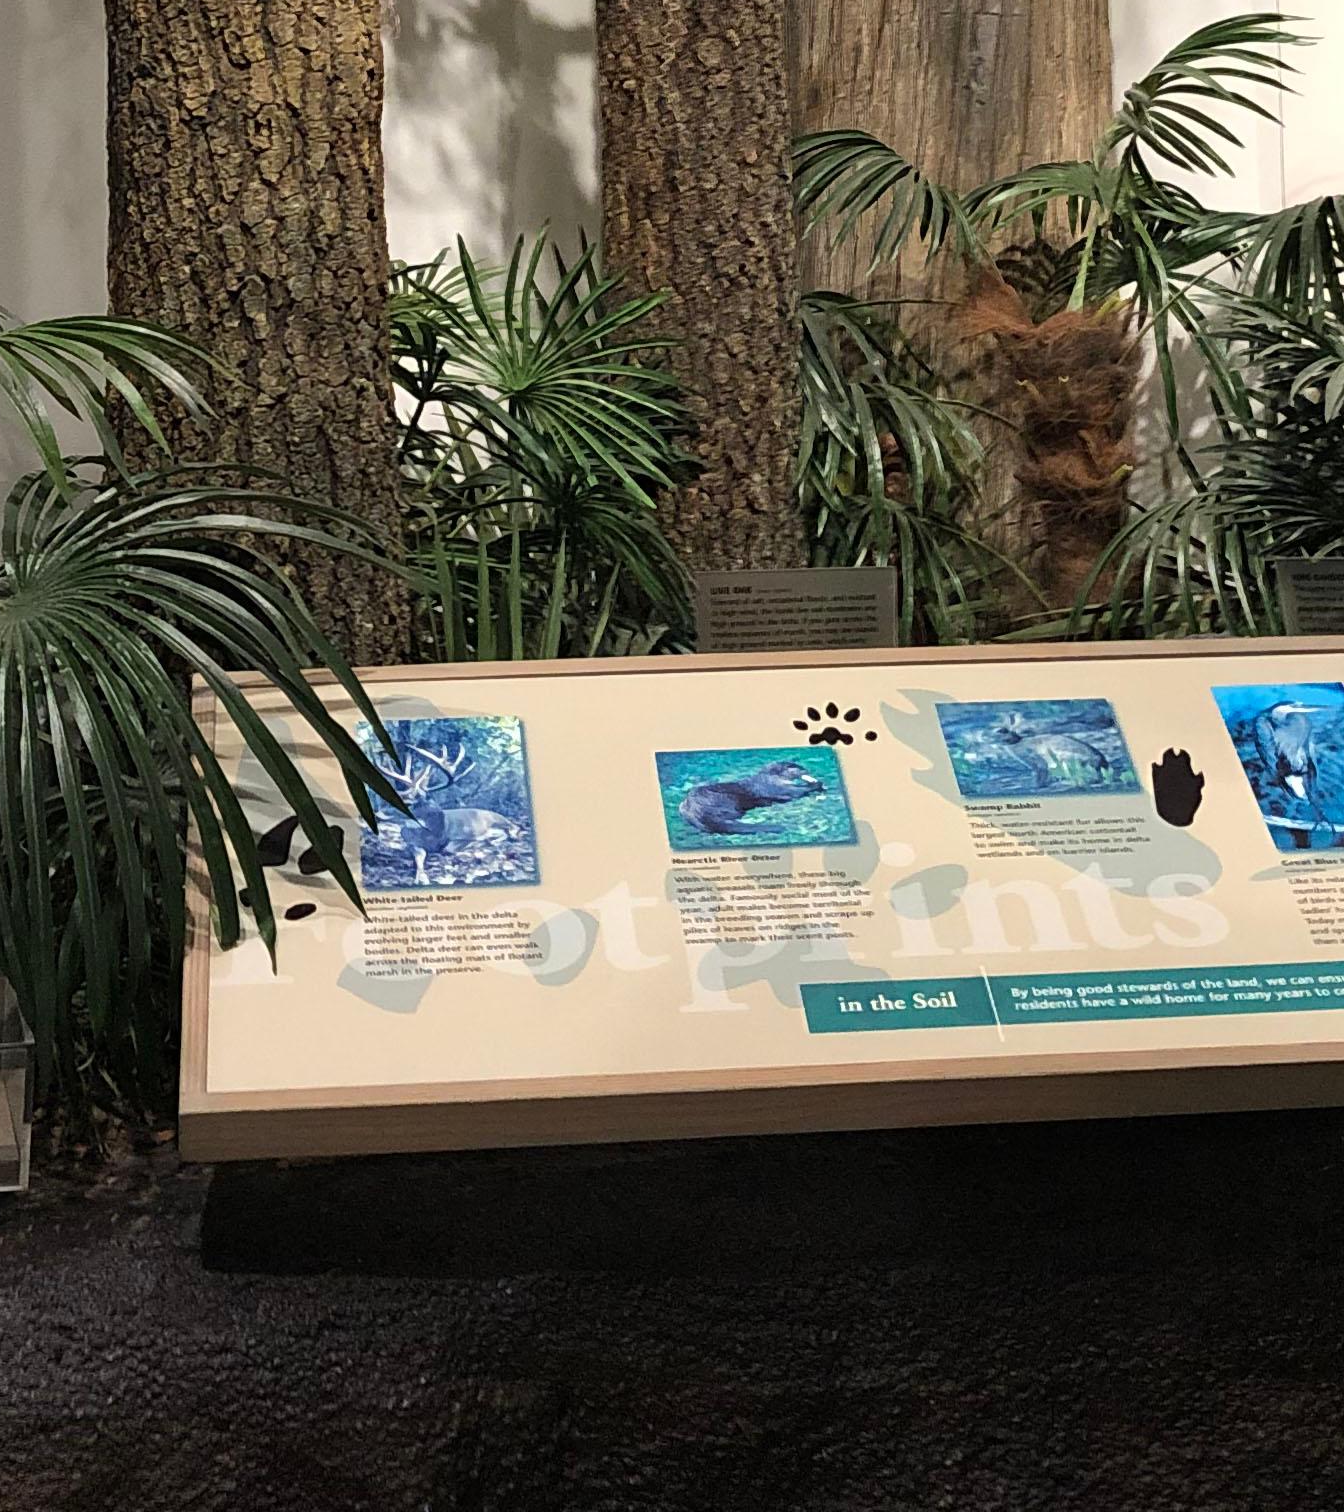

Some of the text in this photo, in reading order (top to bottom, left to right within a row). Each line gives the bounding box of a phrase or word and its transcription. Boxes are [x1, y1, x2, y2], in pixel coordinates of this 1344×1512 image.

[964, 802, 1041, 813] Swamp Rabbit
[720, 855, 749, 863] River
[751, 853, 781, 862] Otter
[1281, 858, 1312, 867] Great
[1314, 857, 1339, 865] Blue
[436, 894, 464, 903] Deer
[1010, 989, 1028, 1000] By
[1031, 987, 1073, 999] being
[1076, 985, 1113, 997] good
[1116, 982, 1179, 993] stewards
[1181, 981, 1196, 990] of
[1200, 980, 1224, 990] the
[1225, 978, 1262, 989] land,
[838, 992, 958, 1013] in the Soil
[1014, 999, 1078, 1010] residents
[1080, 997, 1116, 1007] have
[1130, 995, 1162, 1005] wild
[1163, 993, 1205, 1004] home
[1208, 992, 1229, 1002] for
[1233, 992, 1272, 1002] many
[1273, 990, 1312, 1001] years
[1313, 988, 1331, 997] to
